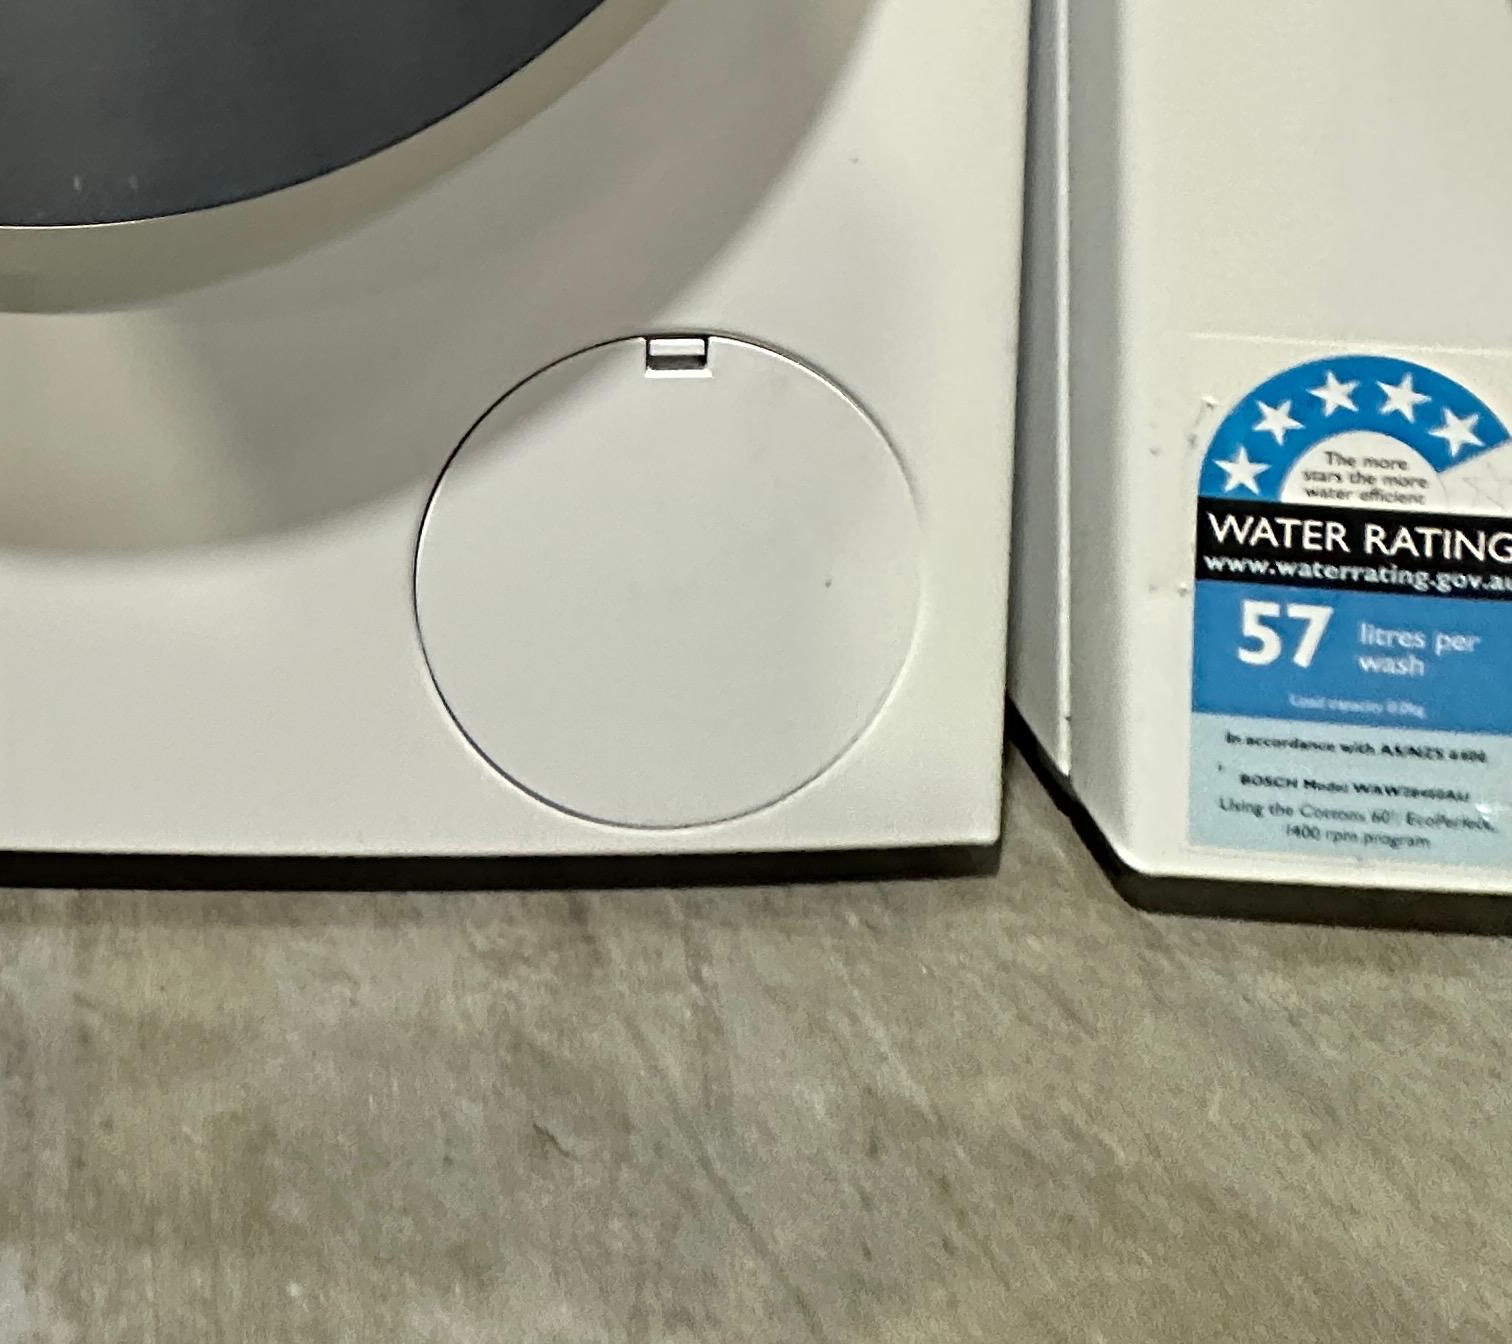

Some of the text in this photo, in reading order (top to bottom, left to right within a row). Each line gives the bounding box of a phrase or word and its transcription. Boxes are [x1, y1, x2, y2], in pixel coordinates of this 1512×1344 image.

[1324, 450, 1408, 471] The more
[1302, 469, 1429, 490] stars the more
[1304, 487, 1426, 505] water efficient
[1206, 511, 1512, 564] WATER RATING
[1237, 598, 1335, 668] 57
[1360, 621, 1480, 656] litres per
[1358, 654, 1425, 676] wash
[1246, 736, 1336, 752] accordance
[1239, 773, 1298, 789] BOSCH
[1303, 779, 1348, 793] Model
[1218, 797, 1264, 818] Using
[1268, 801, 1293, 815] the
